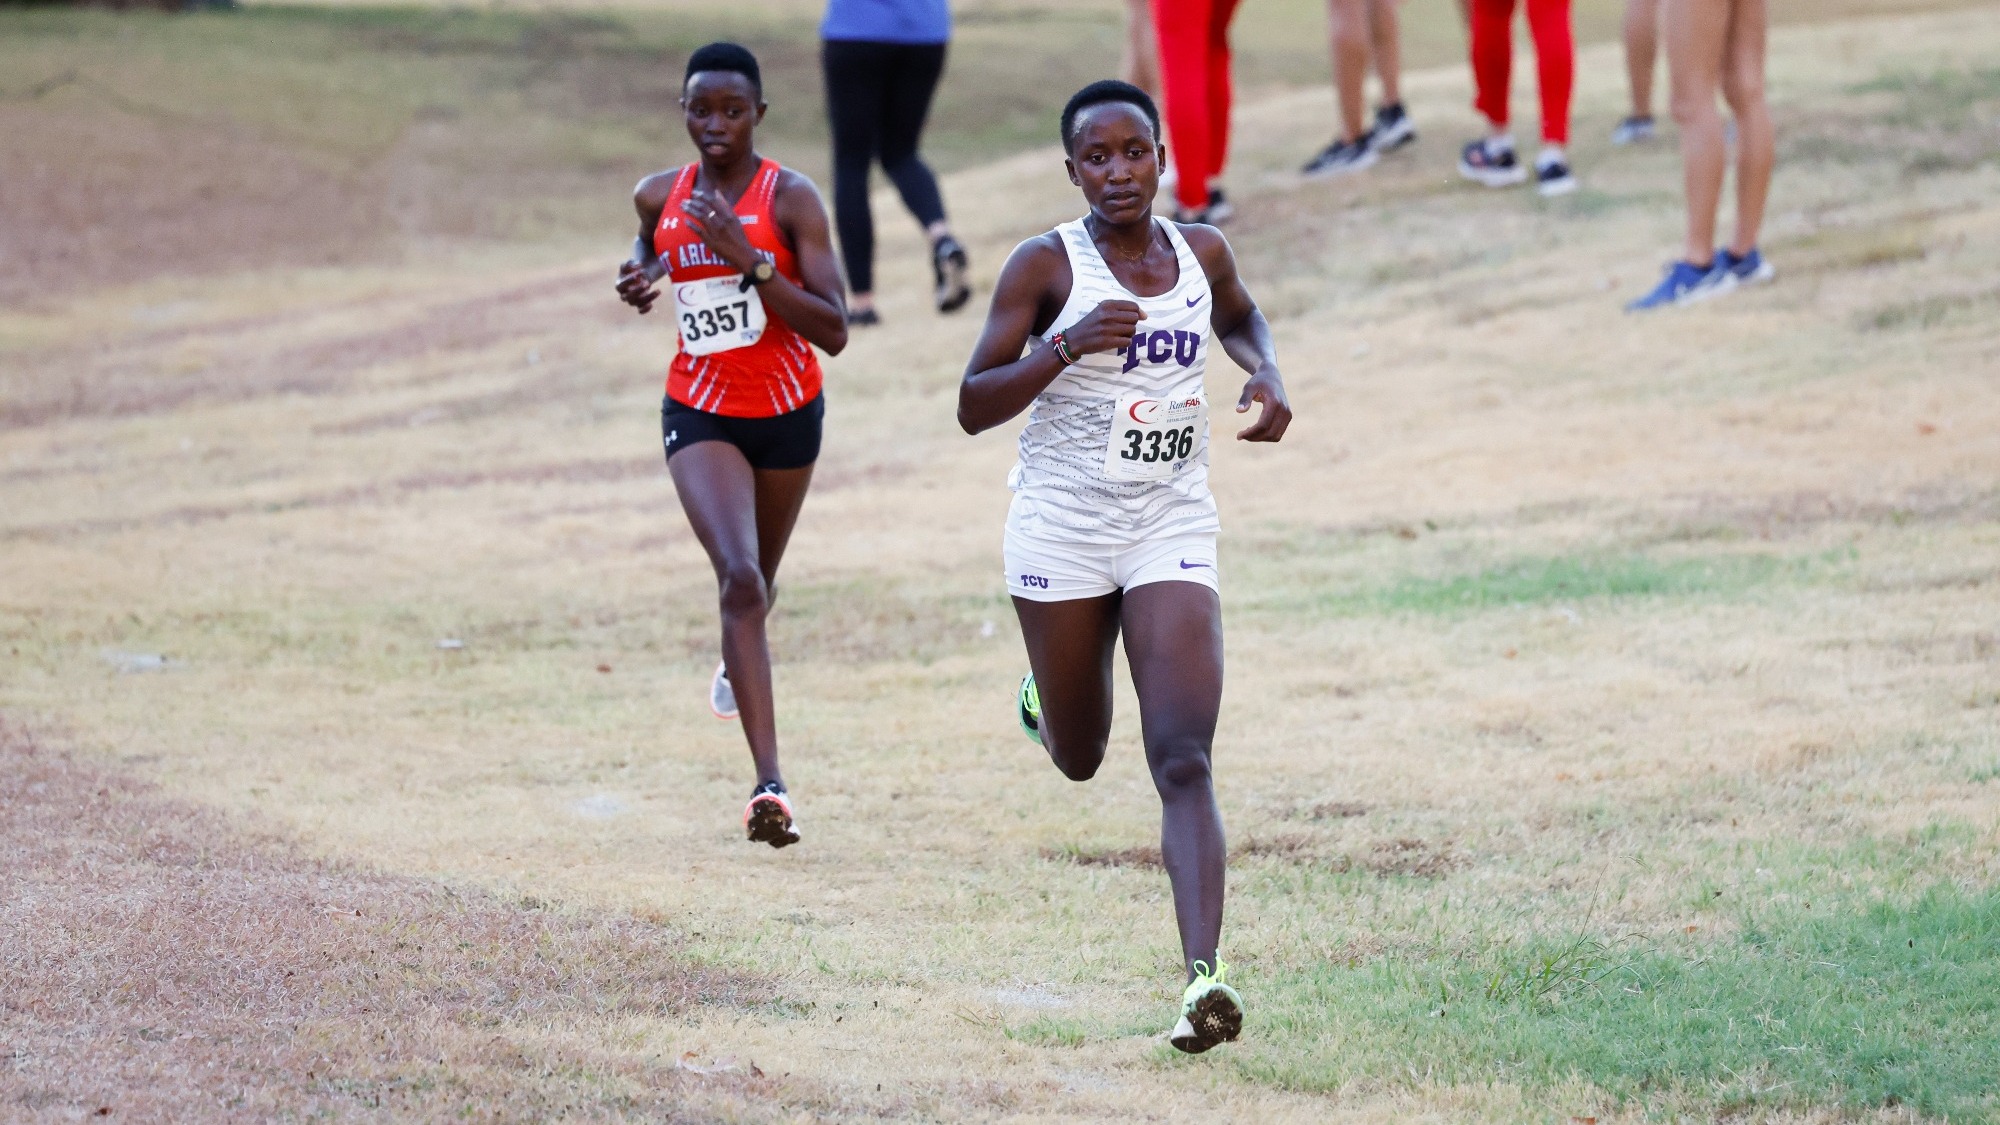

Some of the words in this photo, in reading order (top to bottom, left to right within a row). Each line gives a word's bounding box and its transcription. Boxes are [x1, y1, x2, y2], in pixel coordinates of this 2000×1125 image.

[683, 301, 749, 342] 3357
[1117, 330, 1200, 374] TCU
[1121, 425, 1194, 463] 3336
[1021, 574, 1049, 590] TCU
